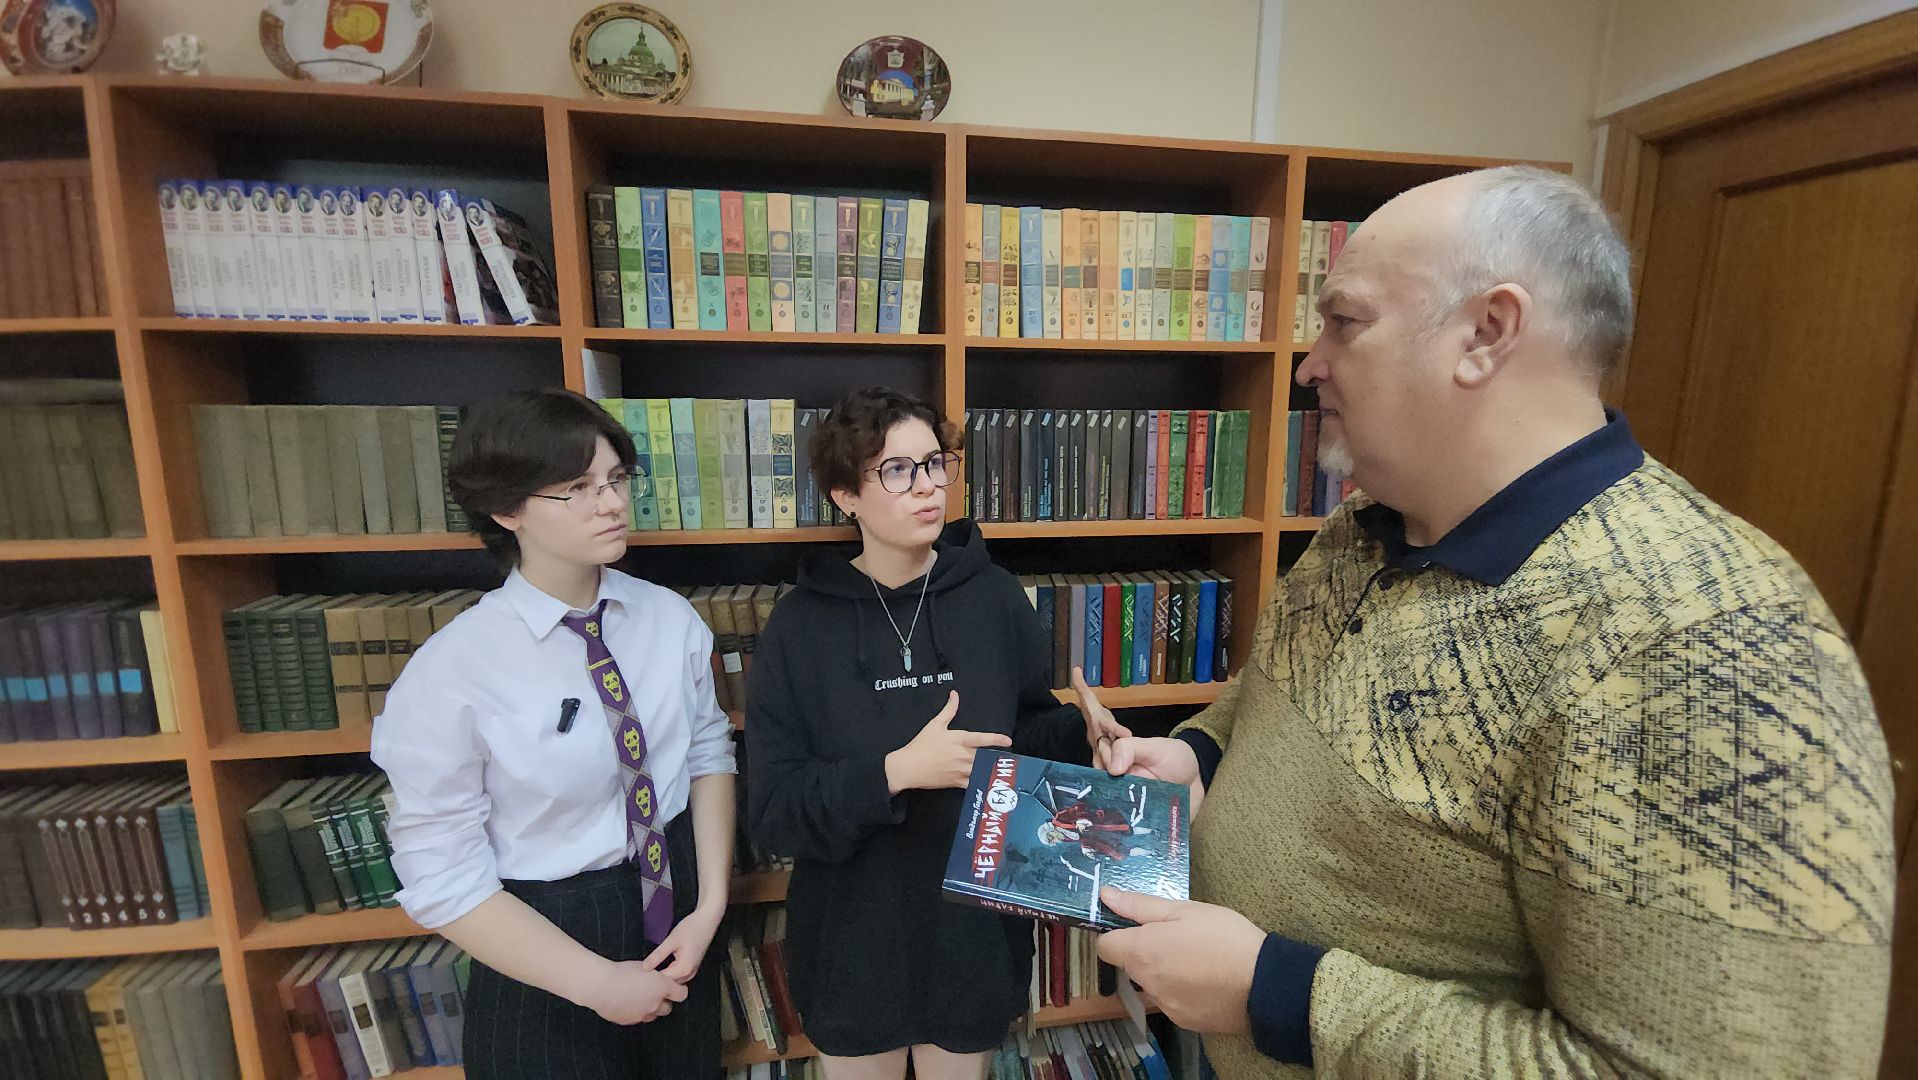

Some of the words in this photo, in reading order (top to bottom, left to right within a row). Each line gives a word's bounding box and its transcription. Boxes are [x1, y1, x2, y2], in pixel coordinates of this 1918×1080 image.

[874, 676, 918, 691] Crushing
[922, 675, 934, 684] on
[937, 672, 954, 684] you
[974, 811, 1004, 879] ЧЁРНЫЙ
[991, 758, 1016, 805] БАРИН
[83, 912, 93, 924] 2
[102, 912, 111, 923] 3
[139, 908, 148, 920] 5
[157, 908, 166, 920] 6
